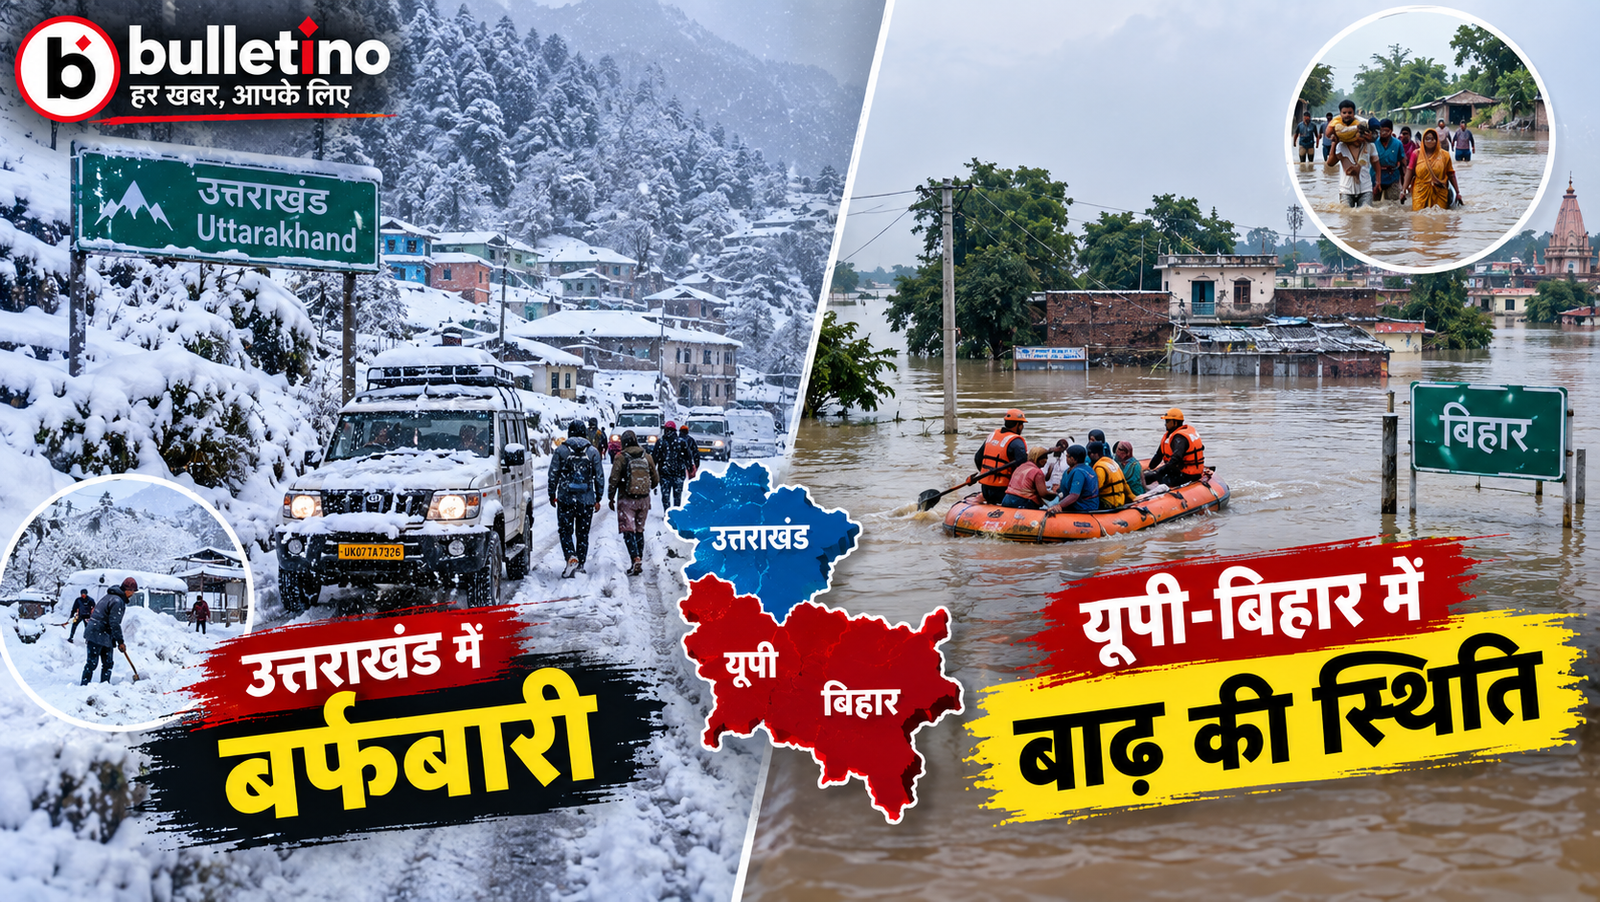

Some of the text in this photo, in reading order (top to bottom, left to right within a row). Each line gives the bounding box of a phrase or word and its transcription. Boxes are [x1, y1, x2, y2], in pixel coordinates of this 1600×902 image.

[197, 177, 330, 216] उत्तराखंड
[197, 213, 357, 253] Uttarakhand
[1439, 402, 1533, 454] बिहार
